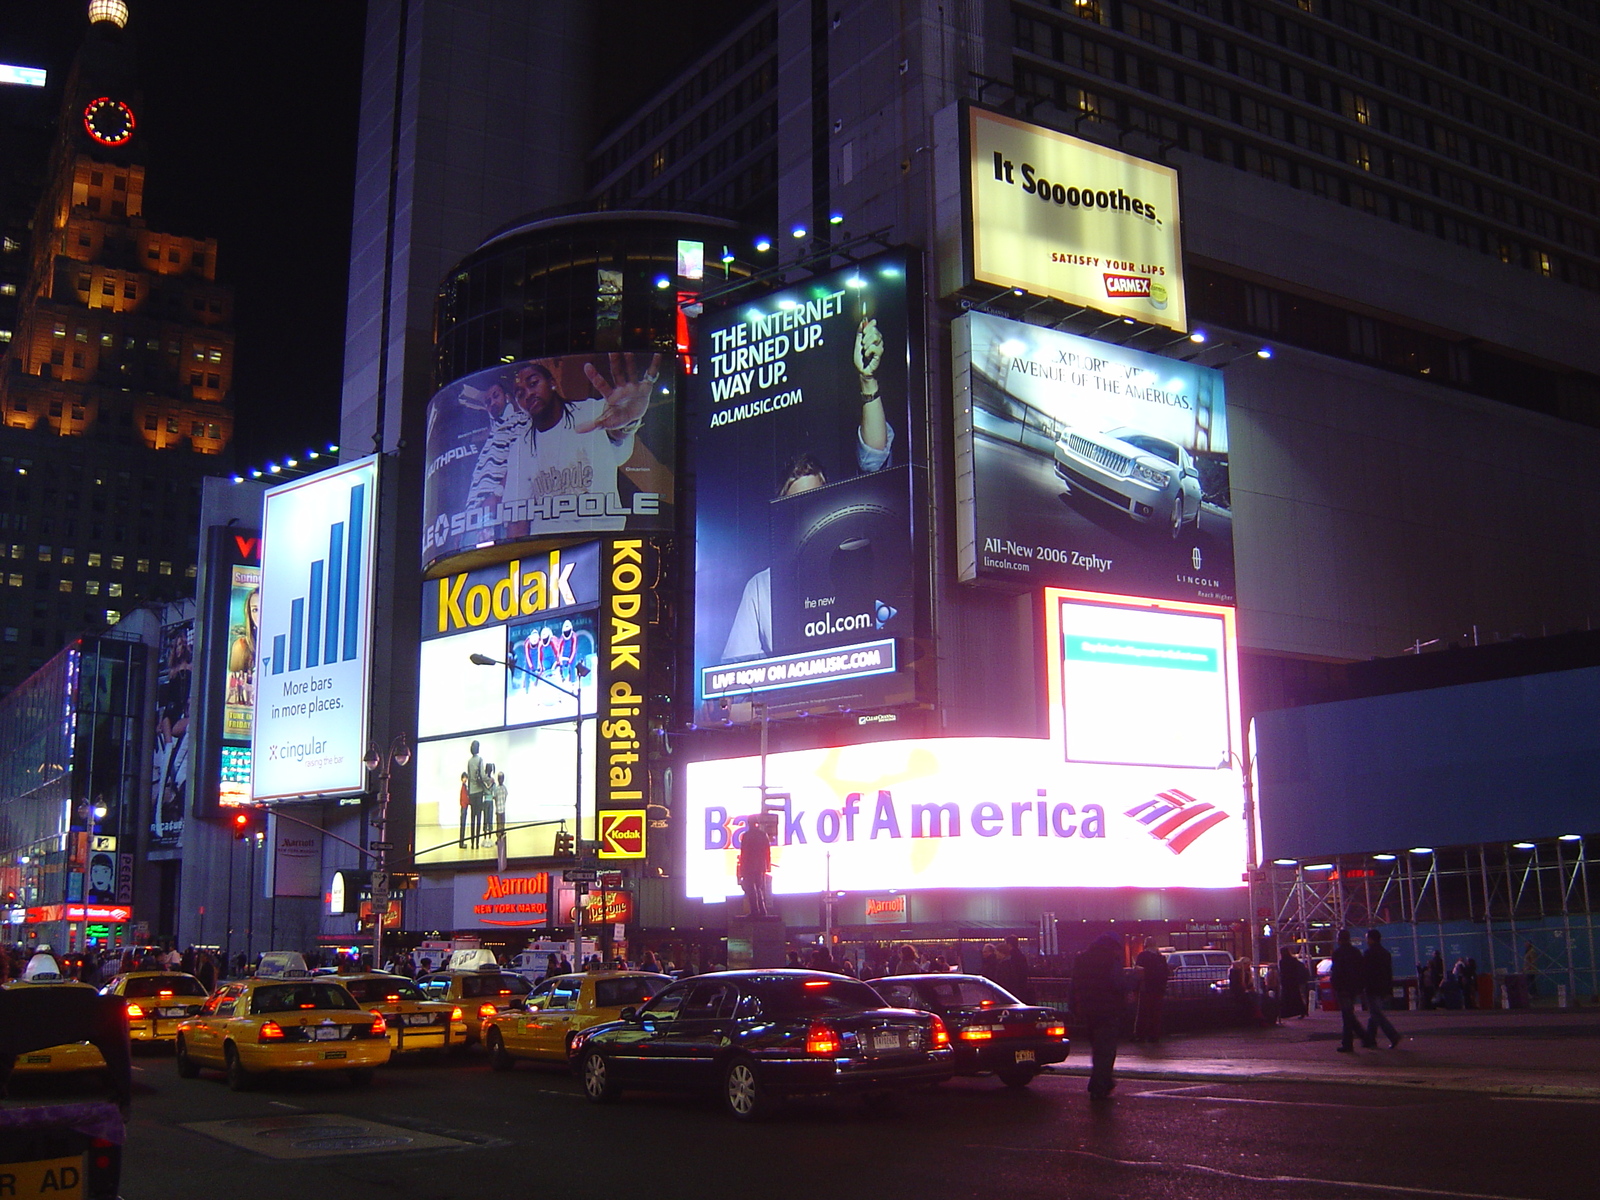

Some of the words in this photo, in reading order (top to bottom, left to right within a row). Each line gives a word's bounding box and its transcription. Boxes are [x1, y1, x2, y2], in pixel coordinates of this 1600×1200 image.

[993, 151, 1015, 184] It
[1051, 252, 1100, 267] SATISFY
[1106, 259, 1135, 273] YOUR
[1141, 264, 1165, 276] LIPS
[1106, 277, 1150, 294] CARMEX
[710, 323, 747, 354] THE
[751, 290, 846, 342] INTERNET
[710, 335, 790, 378] TURNED
[794, 324, 824, 353] UP.
[710, 369, 755, 403] WAY
[758, 361, 788, 389] UP.
[1011, 357, 1067, 382] AVENUE
[1072, 371, 1090, 387] OF
[1093, 375, 1121, 395] THE
[1125, 384, 1194, 411] AMERICAS.
[710, 388, 803, 429] AOLMUSIC.COM
[451, 493, 660, 536] SOUTHPOLE
[984, 537, 1033, 558] All-New
[1036, 546, 1068, 564] 2006
[1071, 551, 1113, 572] Zephyr
[984, 556, 1030, 572] lincoln.com
[437, 550, 577, 631] Kodak
[1176, 575, 1220, 587] LINCOLN
[611, 539, 642, 670] KODAK
[804, 596, 817, 609] the
[818, 596, 836, 608] new
[804, 612, 871, 637] aol.com
[713, 672, 735, 690] LIVE
[736, 667, 767, 685] NOW
[768, 664, 787, 681] ON
[788, 650, 881, 678] AOLMUSIC.COM
[283, 680, 308, 697] More
[310, 675, 333, 692] bars
[271, 704, 280, 719] in
[282, 703, 307, 718] more
[308, 695, 344, 719] places.
[280, 735, 327, 762] cingular
[601, 681, 643, 800] digital
[323, 756, 333, 765] the
[333, 754, 345, 764] bar
[705, 793, 807, 850] Bak
[816, 792, 861, 843] of
[870, 788, 1105, 839] America
[611, 829, 641, 840] Kodak
[482, 872, 549, 900] Marriott
[473, 904, 493, 914] NEW
[494, 903, 517, 914] YORK
[865, 897, 904, 915] Marriott
[40, 1167, 79, 1193] AD
